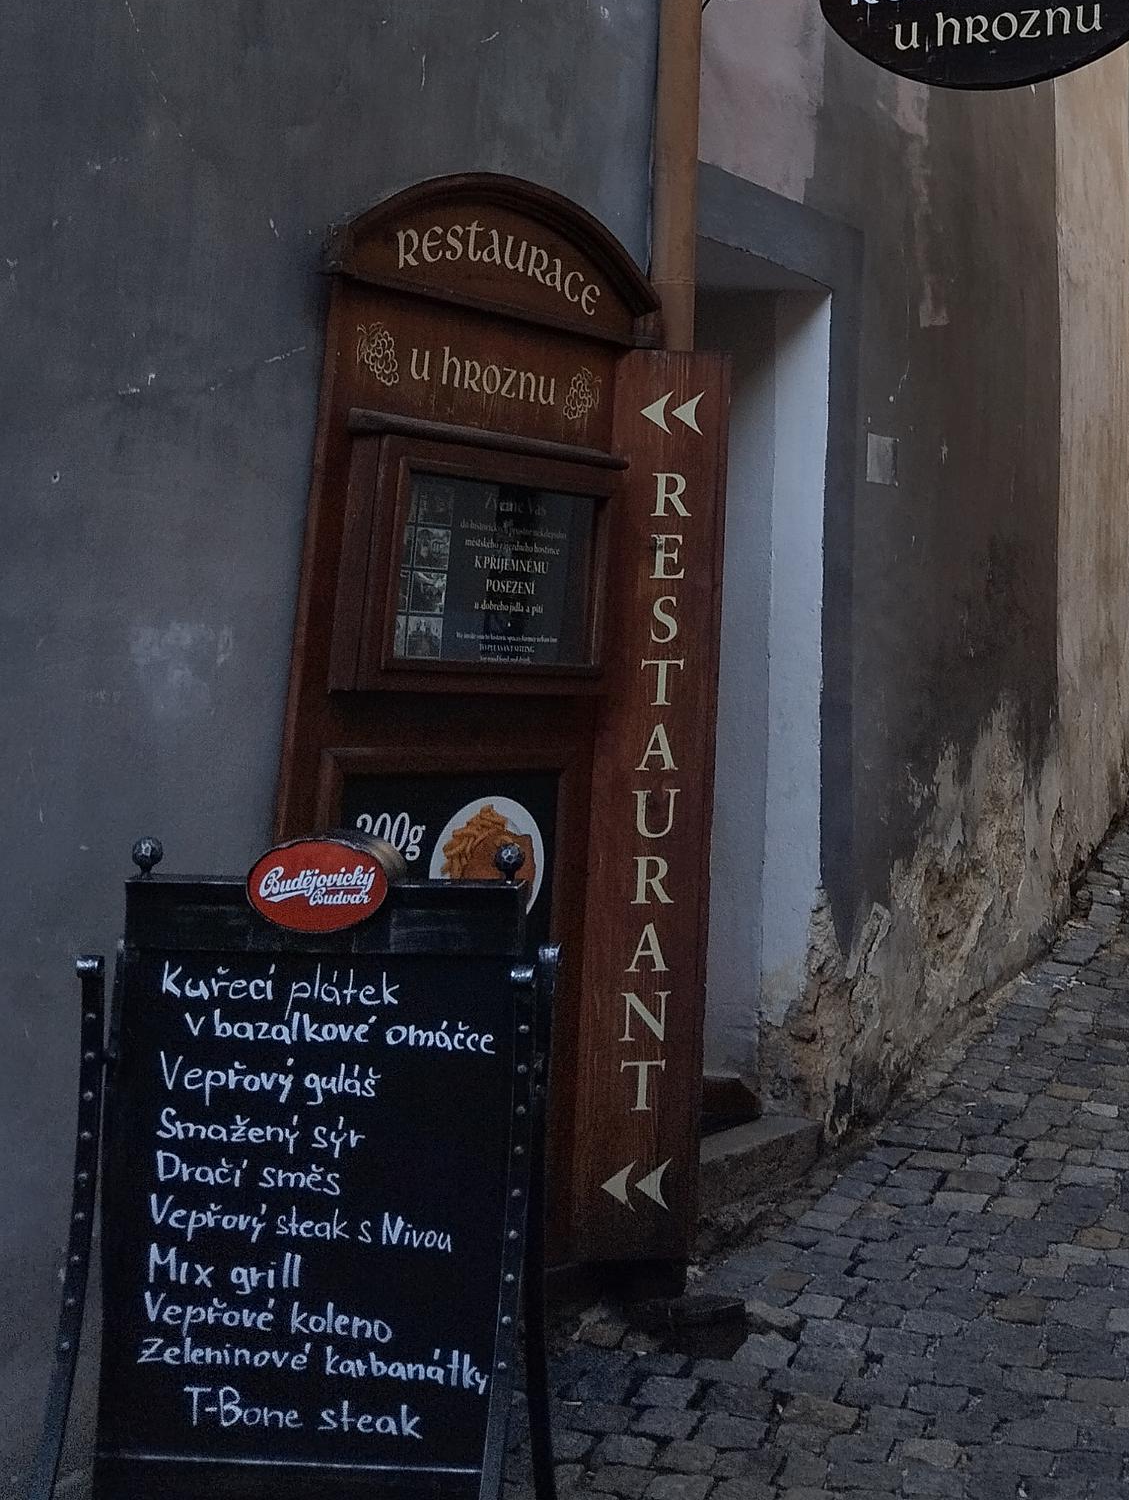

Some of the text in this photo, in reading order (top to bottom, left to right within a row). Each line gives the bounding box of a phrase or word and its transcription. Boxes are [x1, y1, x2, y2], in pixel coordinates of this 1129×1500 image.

[486, 578, 536, 595] POSEZENÍ
[619, 471, 693, 1113] RESTAURANT
[259, 865, 377, 898] Budějovický
[309, 887, 372, 906] Budvar
[161, 960, 401, 1021] Kuřecí plátek
[385, 1020, 496, 1055] omáčce
[160, 1050, 383, 1107] Vepřový guláš
[156, 1106, 367, 1159] Smažený sýr
[156, 1150, 342, 1196] Dračí směs
[149, 1193, 453, 1253] Vepřový steak s Nivou
[230, 1251, 302, 1296] grill
[144, 1290, 394, 1344] Vepřové koleno
[325, 1345, 491, 1396] karbanátky
[183, 1385, 424, 1441] T-Bone steak
